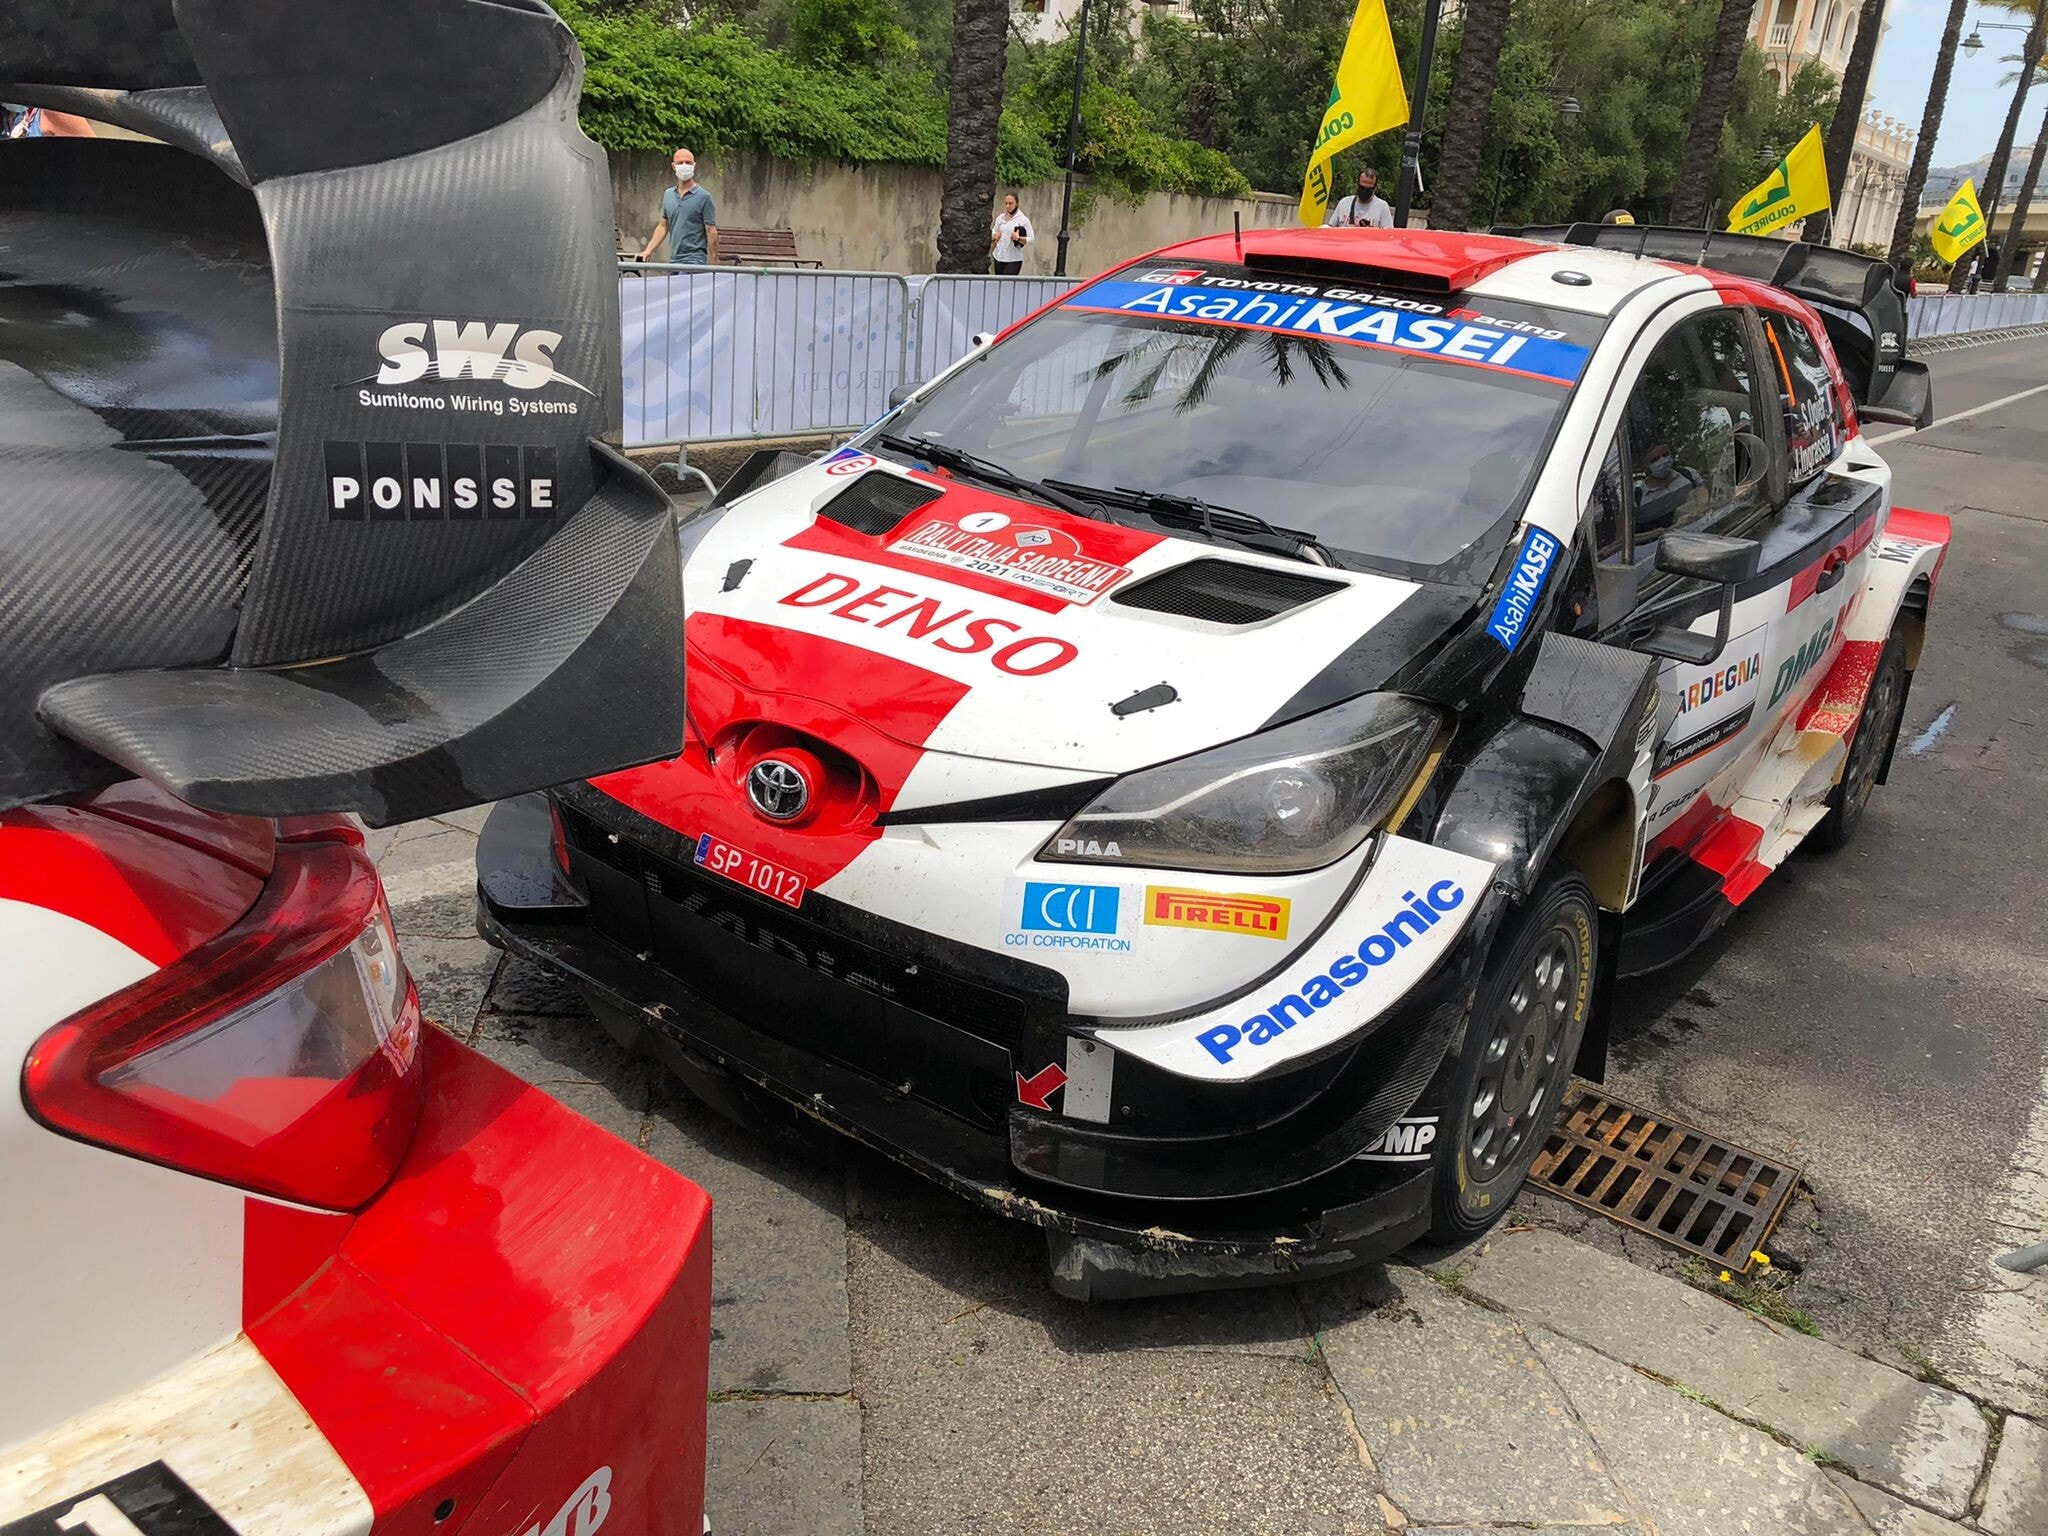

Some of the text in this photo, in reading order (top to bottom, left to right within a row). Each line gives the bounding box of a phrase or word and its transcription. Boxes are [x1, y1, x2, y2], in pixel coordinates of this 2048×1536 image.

[1202, 276, 1318, 296] TOYOTA
[1322, 288, 1443, 314] GAZOO
[1446, 308, 1568, 340] Racing
[376, 319, 563, 389] SWS
[358, 390, 578, 416] Sumitomo Wiring Systems
[332, 476, 553, 509] PONSSE
[910, 522, 1119, 592] RALLY ITALIA SARDEGNA
[966, 559, 1009, 577] 2021
[777, 572, 1079, 676] DENSO
[1677, 653, 1760, 714] ARDEGNA
[710, 844, 801, 903] SP 1012
[1058, 839, 1123, 857] PIAA
[1041, 887, 1096, 930] CCI
[1155, 891, 1281, 932] PIRELLI
[1004, 933, 1131, 951] CCI CORPORATION
[1195, 880, 1464, 1065] Panasonic
